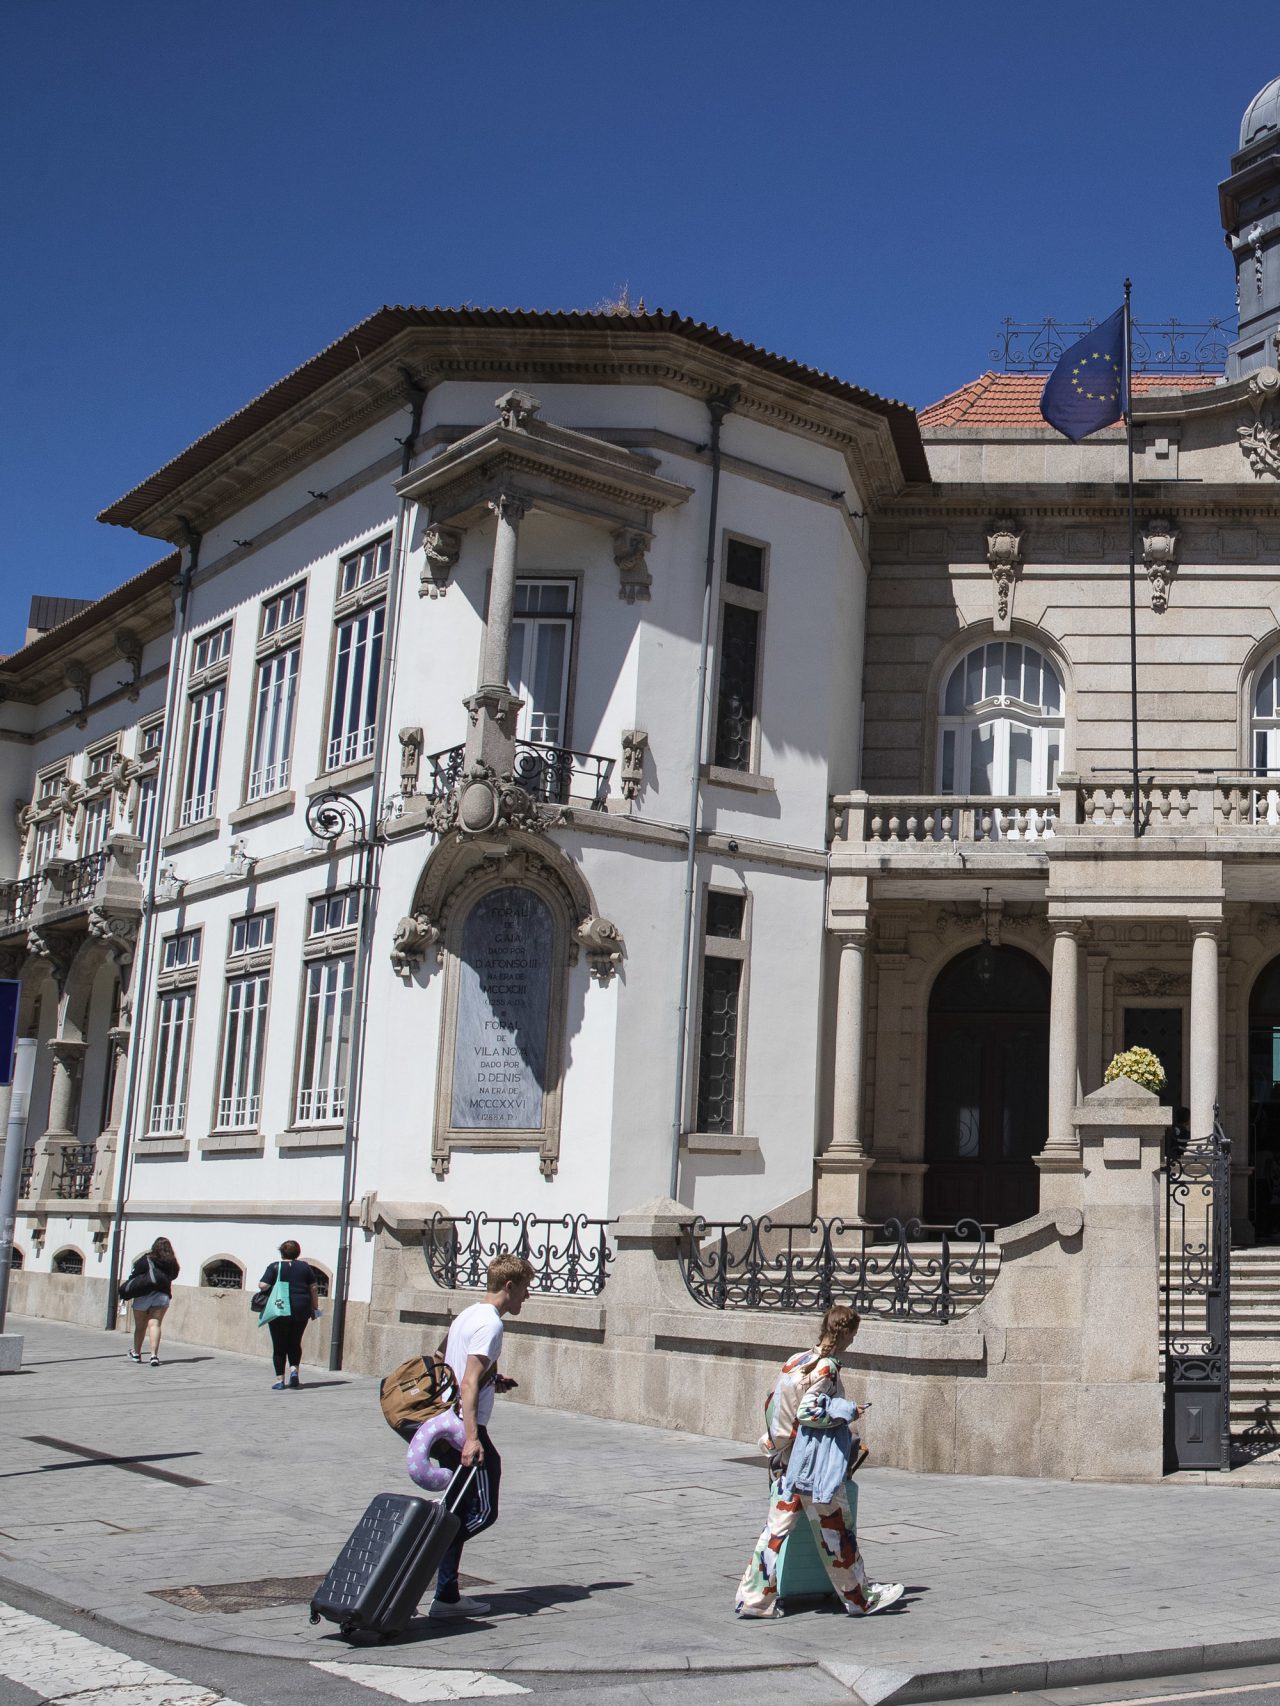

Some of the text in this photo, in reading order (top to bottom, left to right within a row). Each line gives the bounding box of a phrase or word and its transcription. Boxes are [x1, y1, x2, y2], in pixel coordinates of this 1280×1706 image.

[485, 960, 528, 969] AFONSO
[485, 1021, 521, 1030] FORAL
[475, 1047, 528, 1056] VILA NOVA
[488, 1073, 521, 1082] DENIS
[469, 1099, 526, 1109] MCCCXXVI
